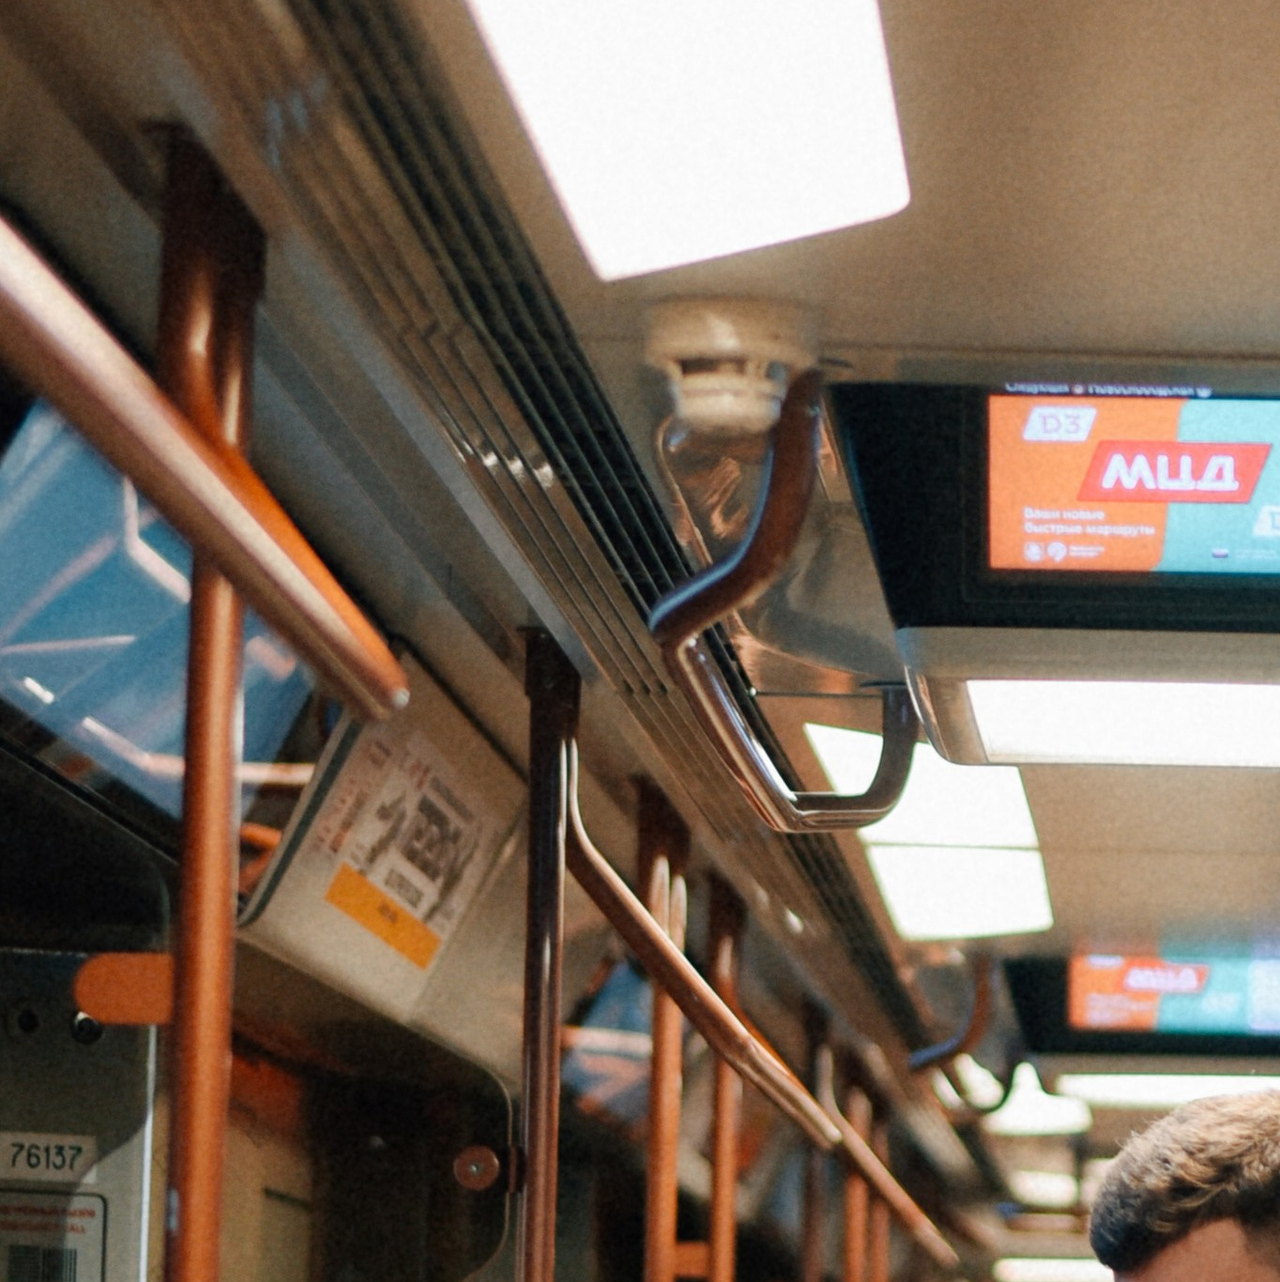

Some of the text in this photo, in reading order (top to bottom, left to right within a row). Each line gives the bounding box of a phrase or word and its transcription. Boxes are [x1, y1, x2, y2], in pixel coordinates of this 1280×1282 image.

[1040, 414, 1082, 435] D3
[1101, 453, 1240, 492] МЦД
[11, 1142, 82, 1171] 76137
